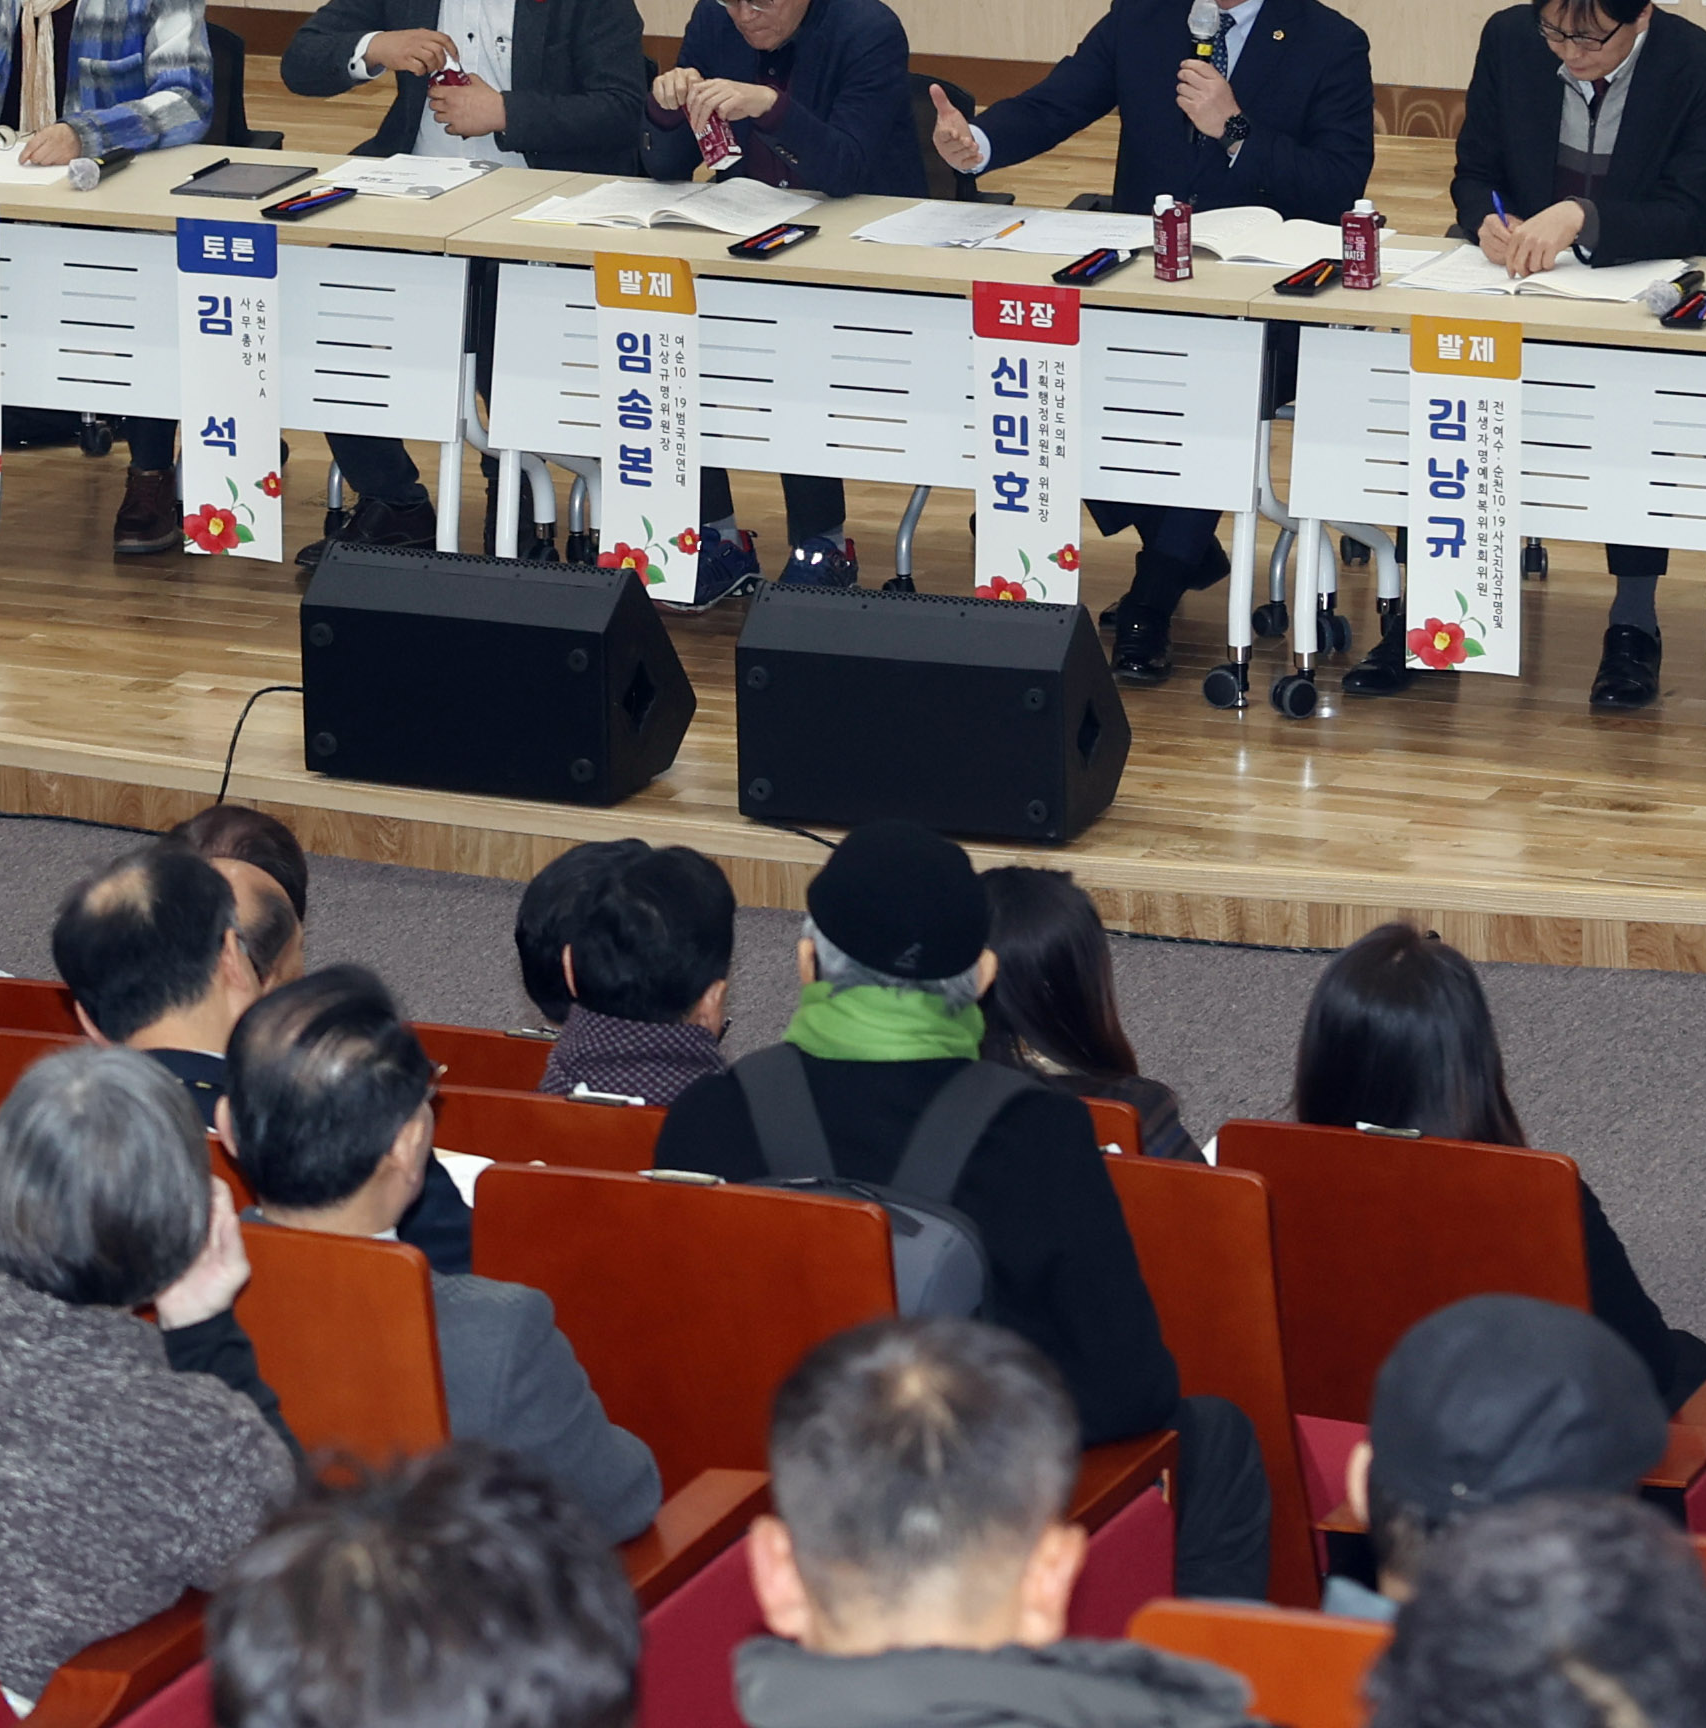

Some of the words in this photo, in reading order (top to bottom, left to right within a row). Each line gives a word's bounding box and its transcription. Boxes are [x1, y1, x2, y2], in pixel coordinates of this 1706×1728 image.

[202, 235, 255, 262] 토론
[1344, 250, 1366, 261] WATER
[618, 269, 673, 298] 발제
[999, 299, 1056, 329] 좌장
[1437, 333, 1495, 363] 발제
[616, 332, 654, 488] 임송본
[990, 356, 1030, 514] 신민호
[1425, 398, 1470, 559] 김낭규
